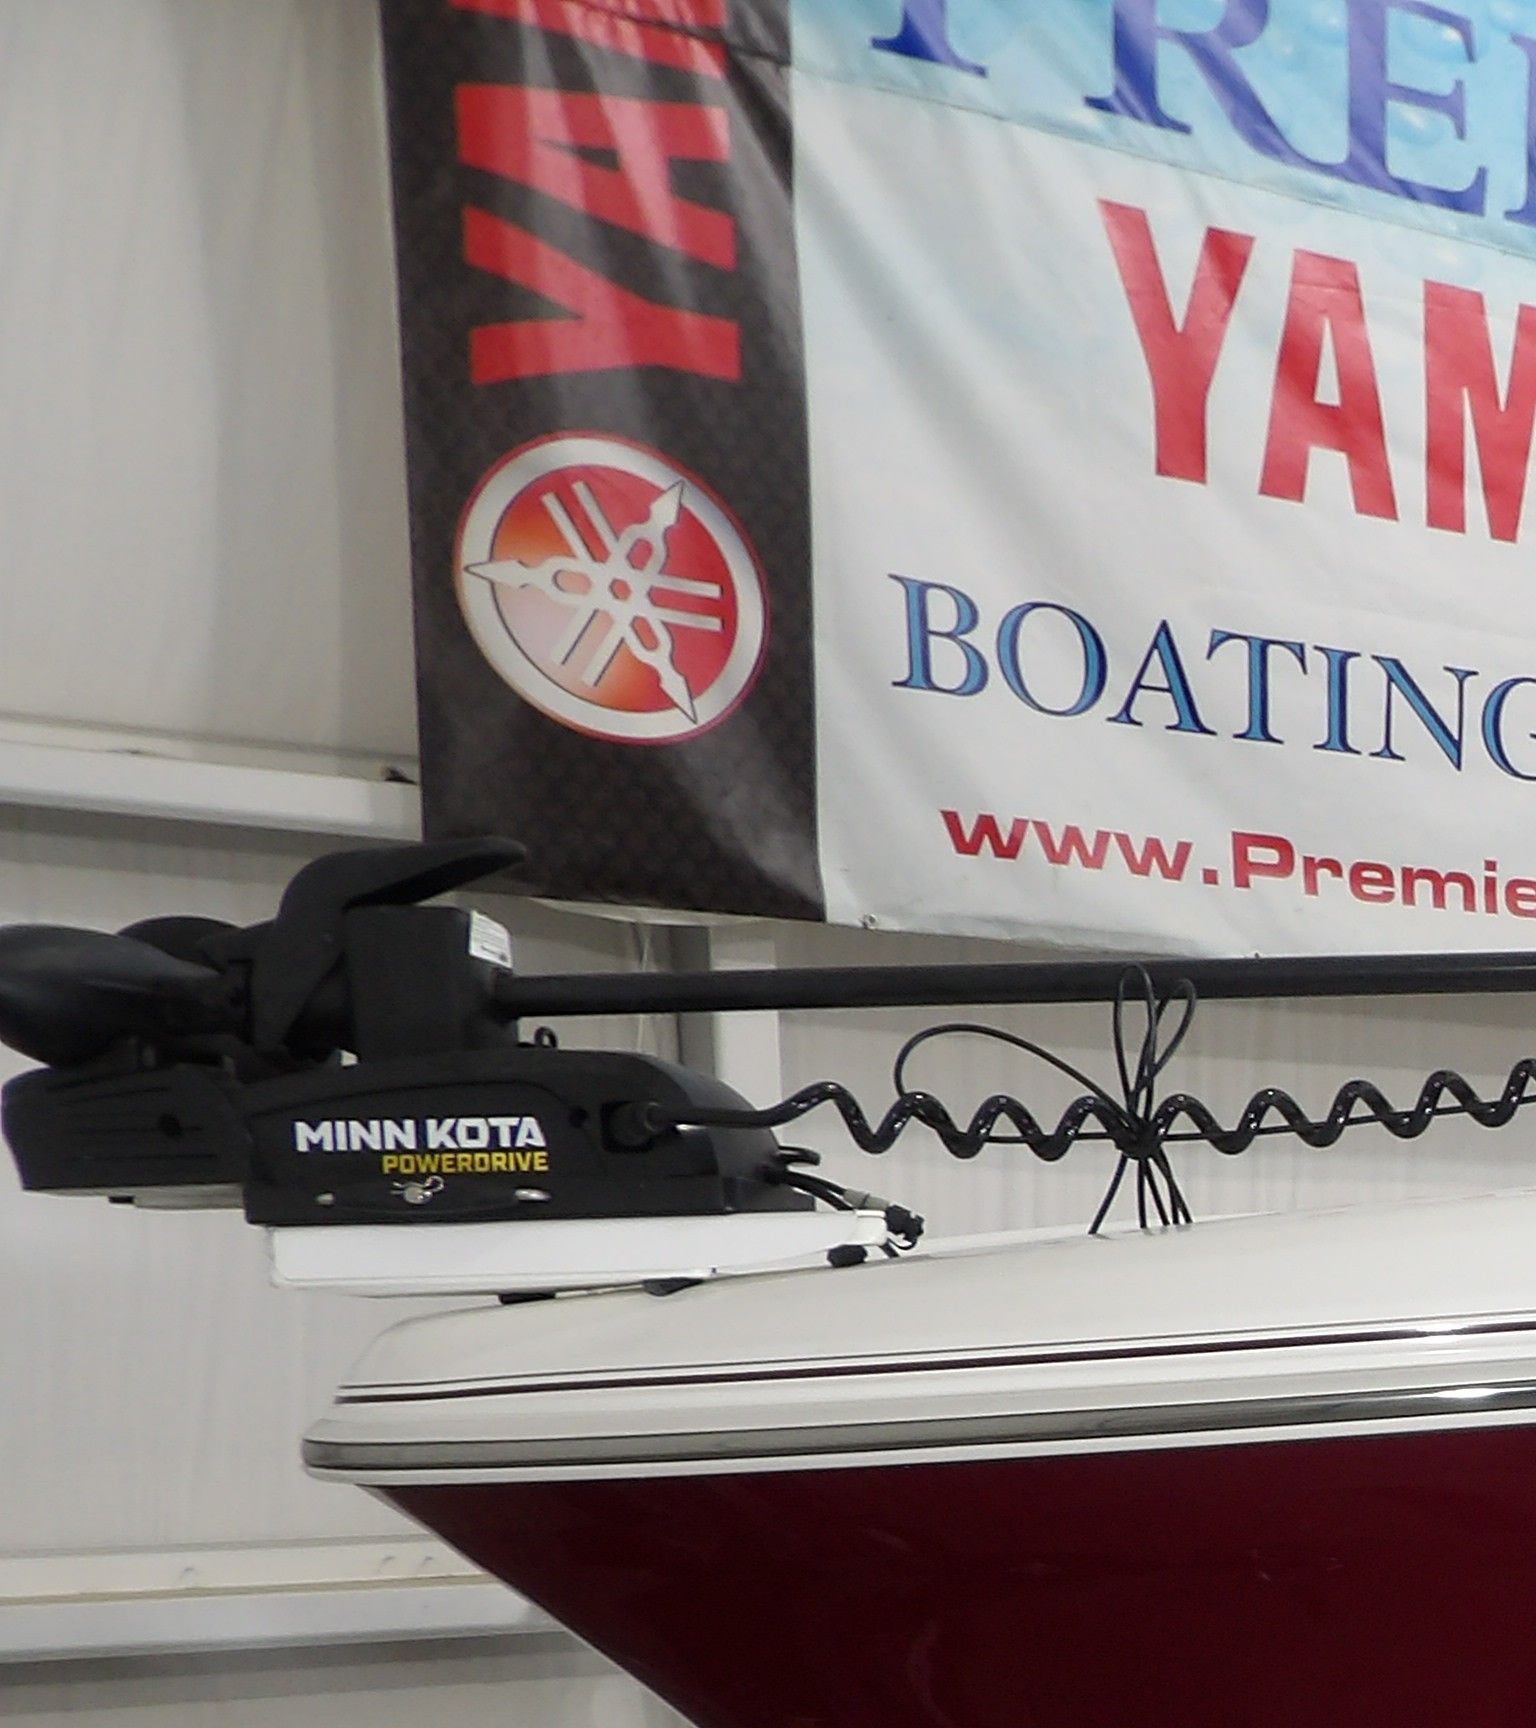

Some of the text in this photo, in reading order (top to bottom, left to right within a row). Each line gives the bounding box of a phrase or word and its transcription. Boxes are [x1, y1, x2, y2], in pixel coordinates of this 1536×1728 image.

[294, 1115, 547, 1153] MINN KOTA
[382, 1150, 550, 1175] POWERDRIVE
